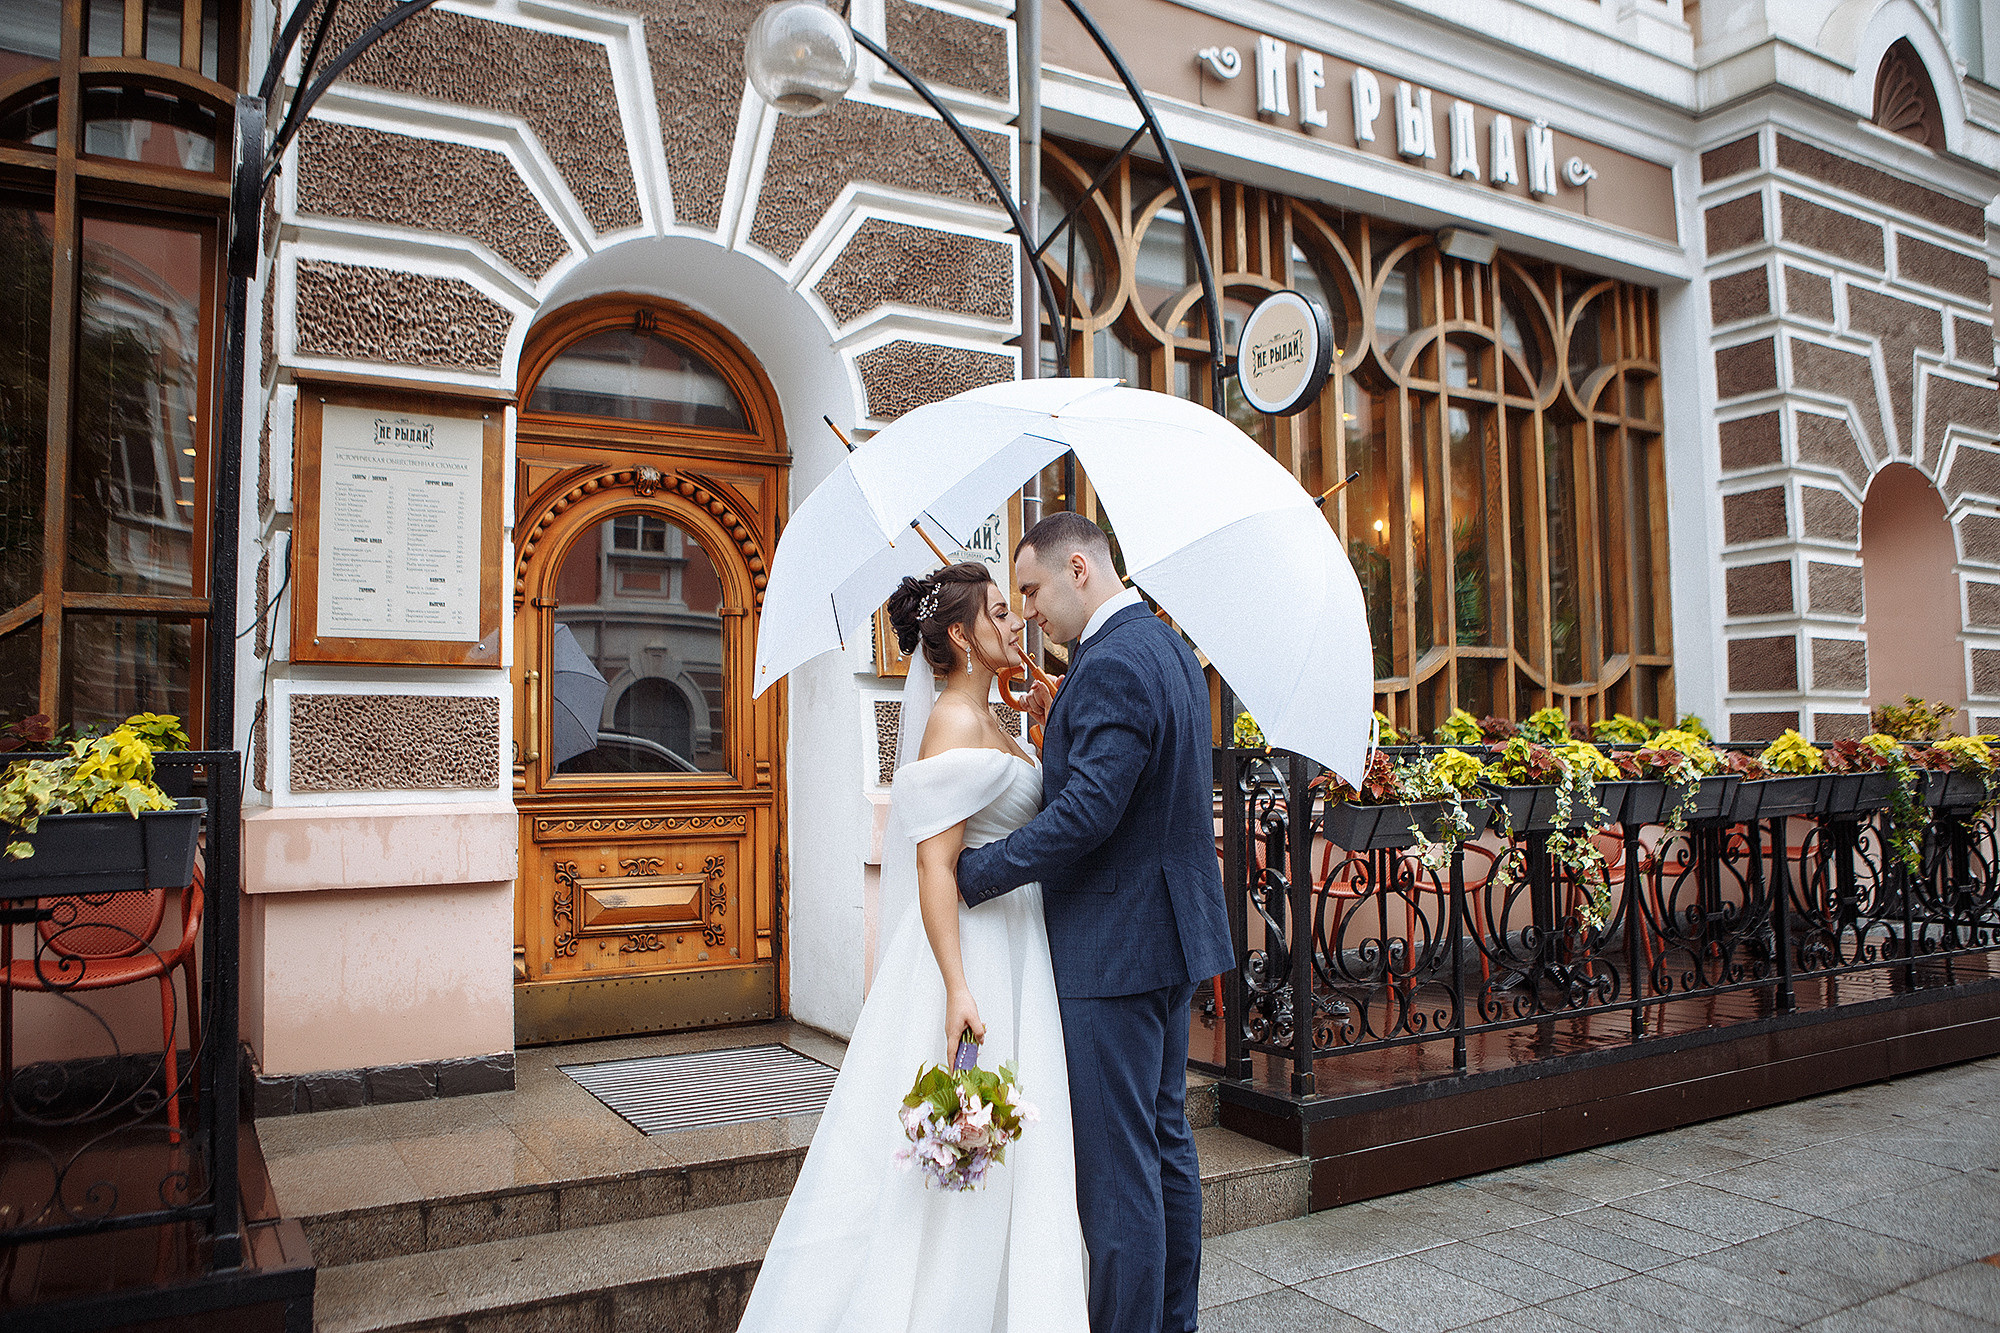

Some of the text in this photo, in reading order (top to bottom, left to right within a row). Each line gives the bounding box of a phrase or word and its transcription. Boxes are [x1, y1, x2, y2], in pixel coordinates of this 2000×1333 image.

[1255, 34, 1558, 197] НЕ РЫДАЙ
[1256, 337, 1299, 369] НЕ РЫДАЙ
[379, 425, 429, 443] НЕ РЫДАЙ
[965, 523, 992, 550] АЙ
